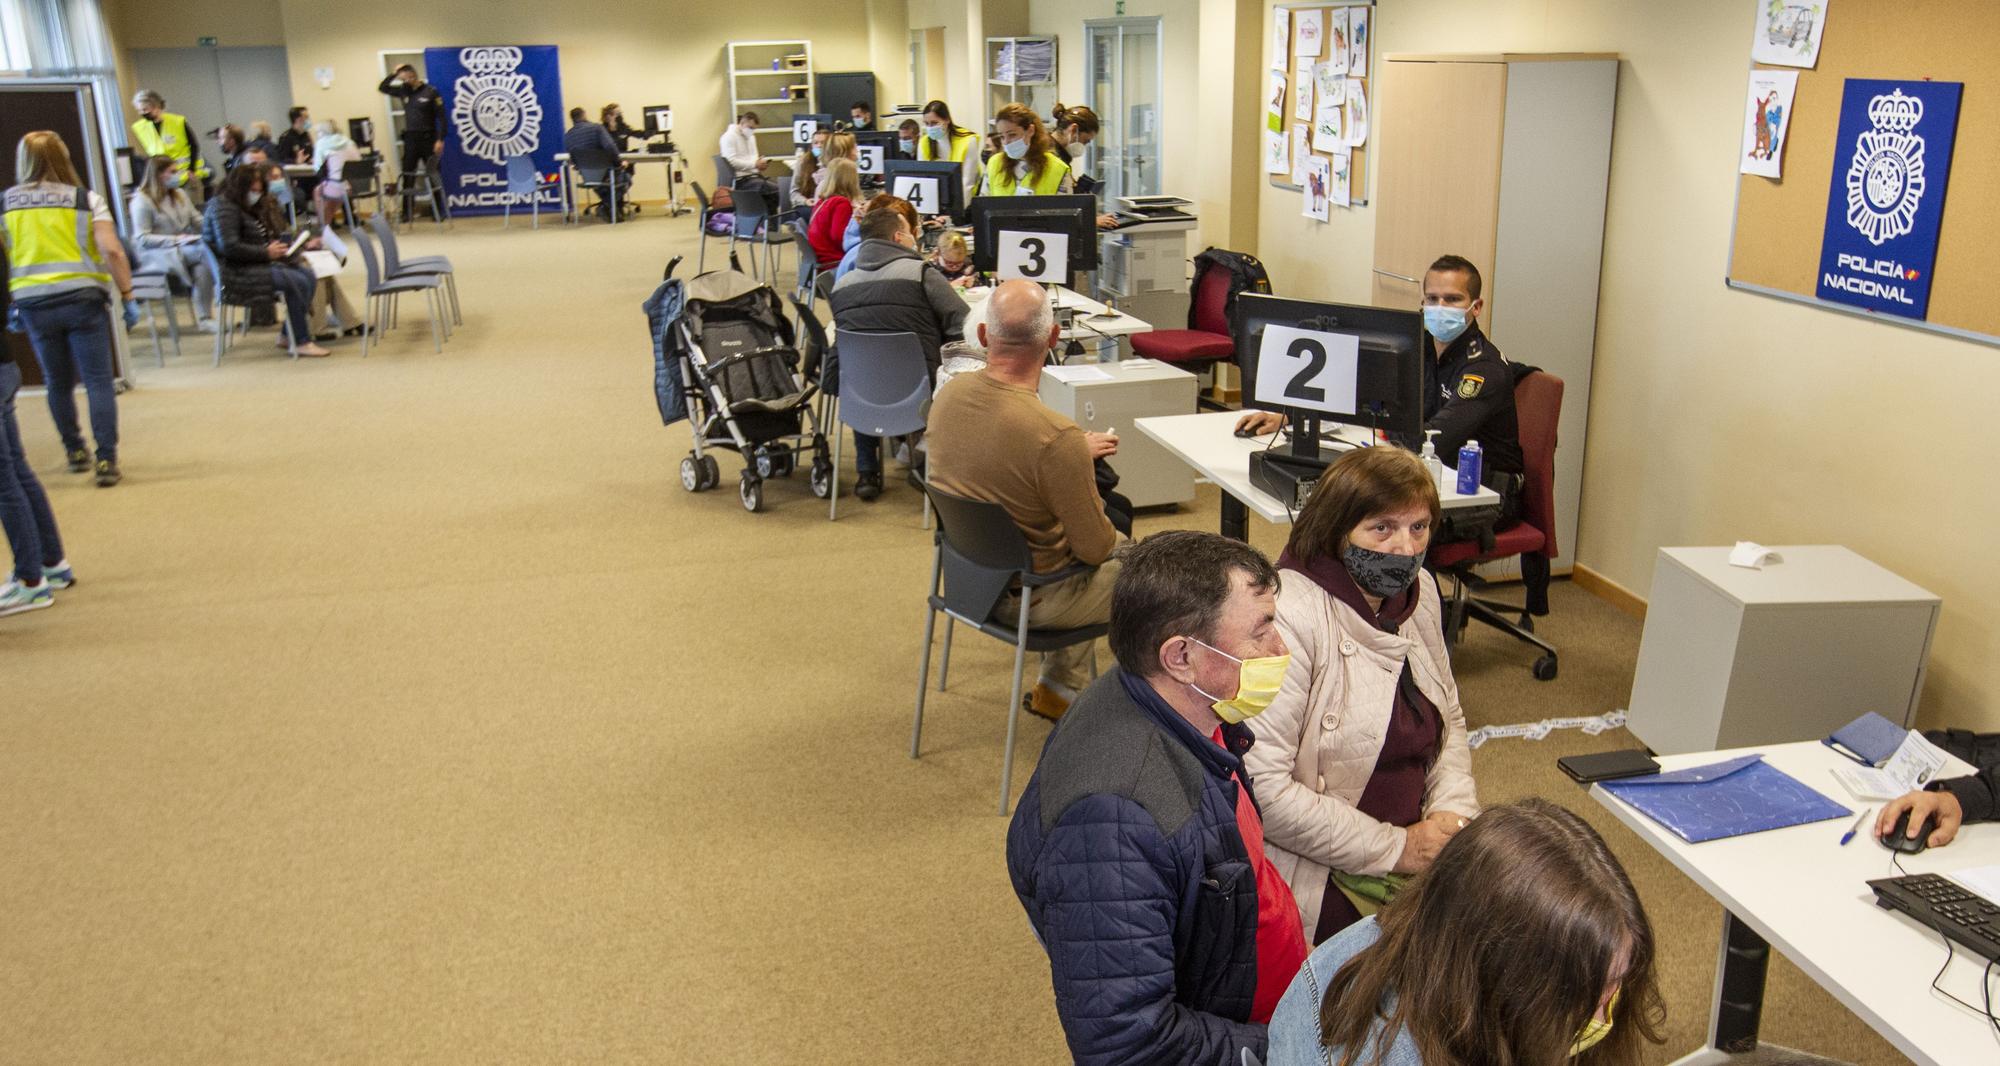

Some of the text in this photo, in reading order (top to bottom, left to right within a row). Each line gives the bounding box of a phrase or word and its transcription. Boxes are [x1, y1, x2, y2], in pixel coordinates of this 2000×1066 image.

[800, 122, 809, 142] 6
[859, 149, 872, 171] 5
[460, 171, 546, 187] POLA
[448, 190, 561, 207] NACIONAL
[907, 183, 923, 207] 4
[1018, 237, 1046, 277] 3
[1837, 252, 1905, 280] POLICÍA
[1823, 272, 1914, 304] NACIONAL
[1283, 338, 1327, 402] 2
